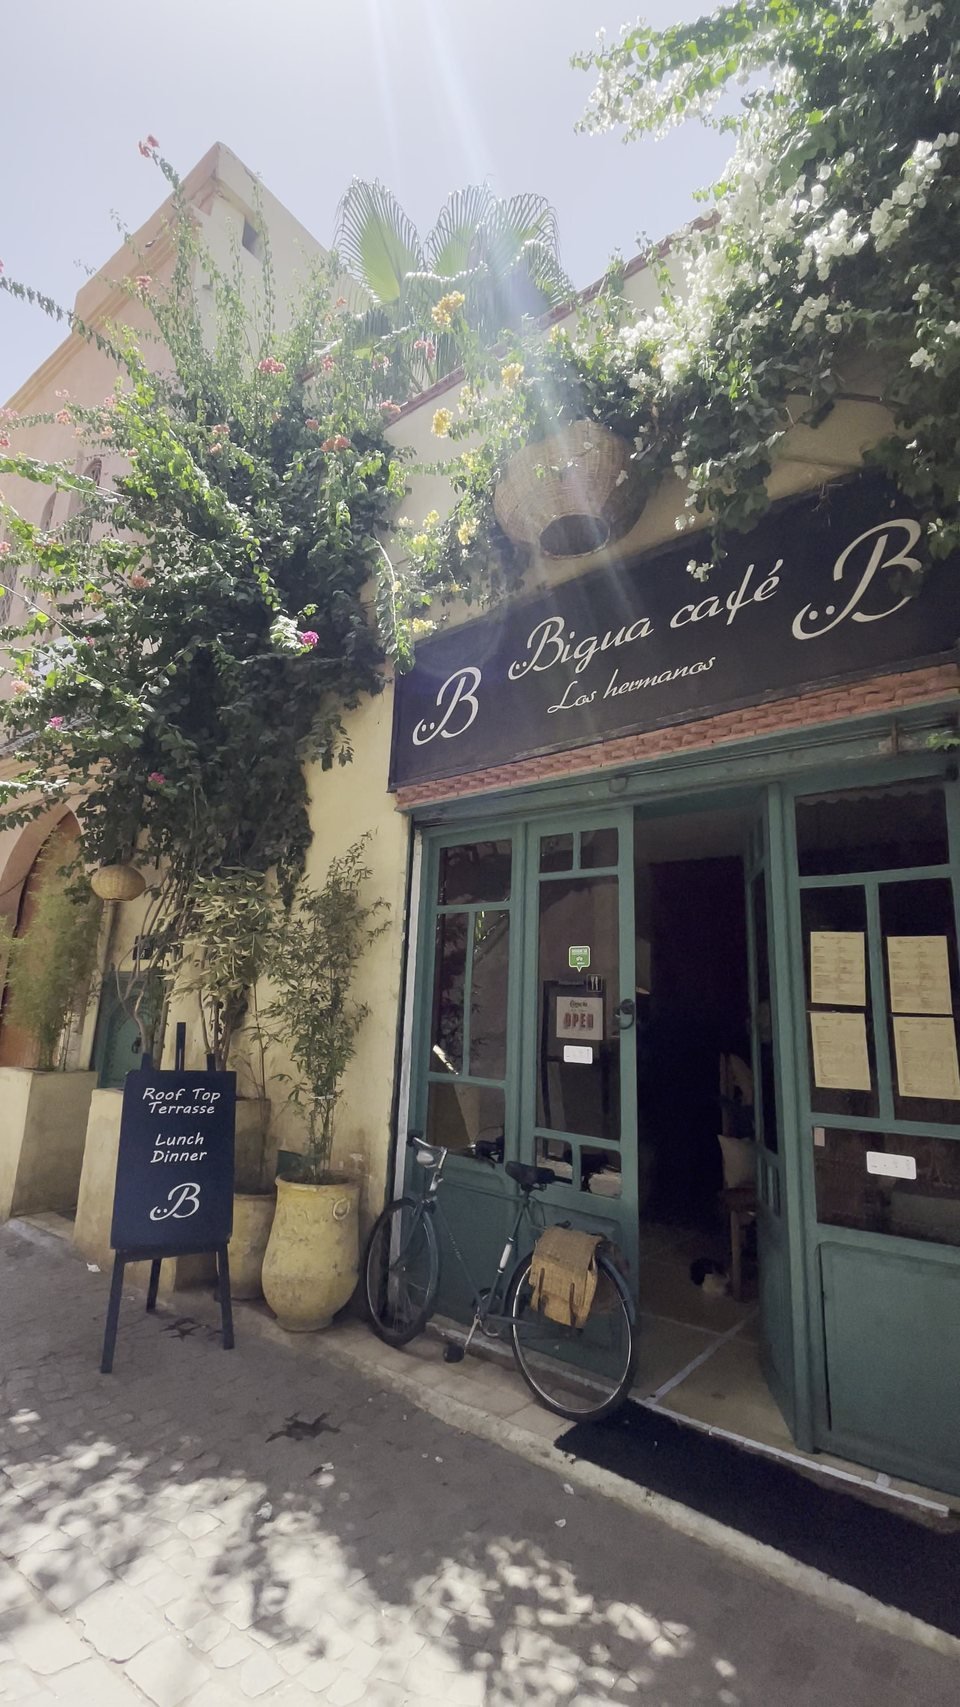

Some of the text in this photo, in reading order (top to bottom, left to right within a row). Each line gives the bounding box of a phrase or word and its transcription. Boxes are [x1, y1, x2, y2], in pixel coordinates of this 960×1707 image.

[508, 559, 784, 680] Bigua café
[547, 656, 716, 714] Los hermanos
[563, 1012, 594, 1030] OPEN
[142, 1087, 221, 1103] Roof Top
[148, 1101, 215, 1114] Terrasse
[155, 1132, 204, 1146] Lunch
[150, 1150, 207, 1163] Dinner
